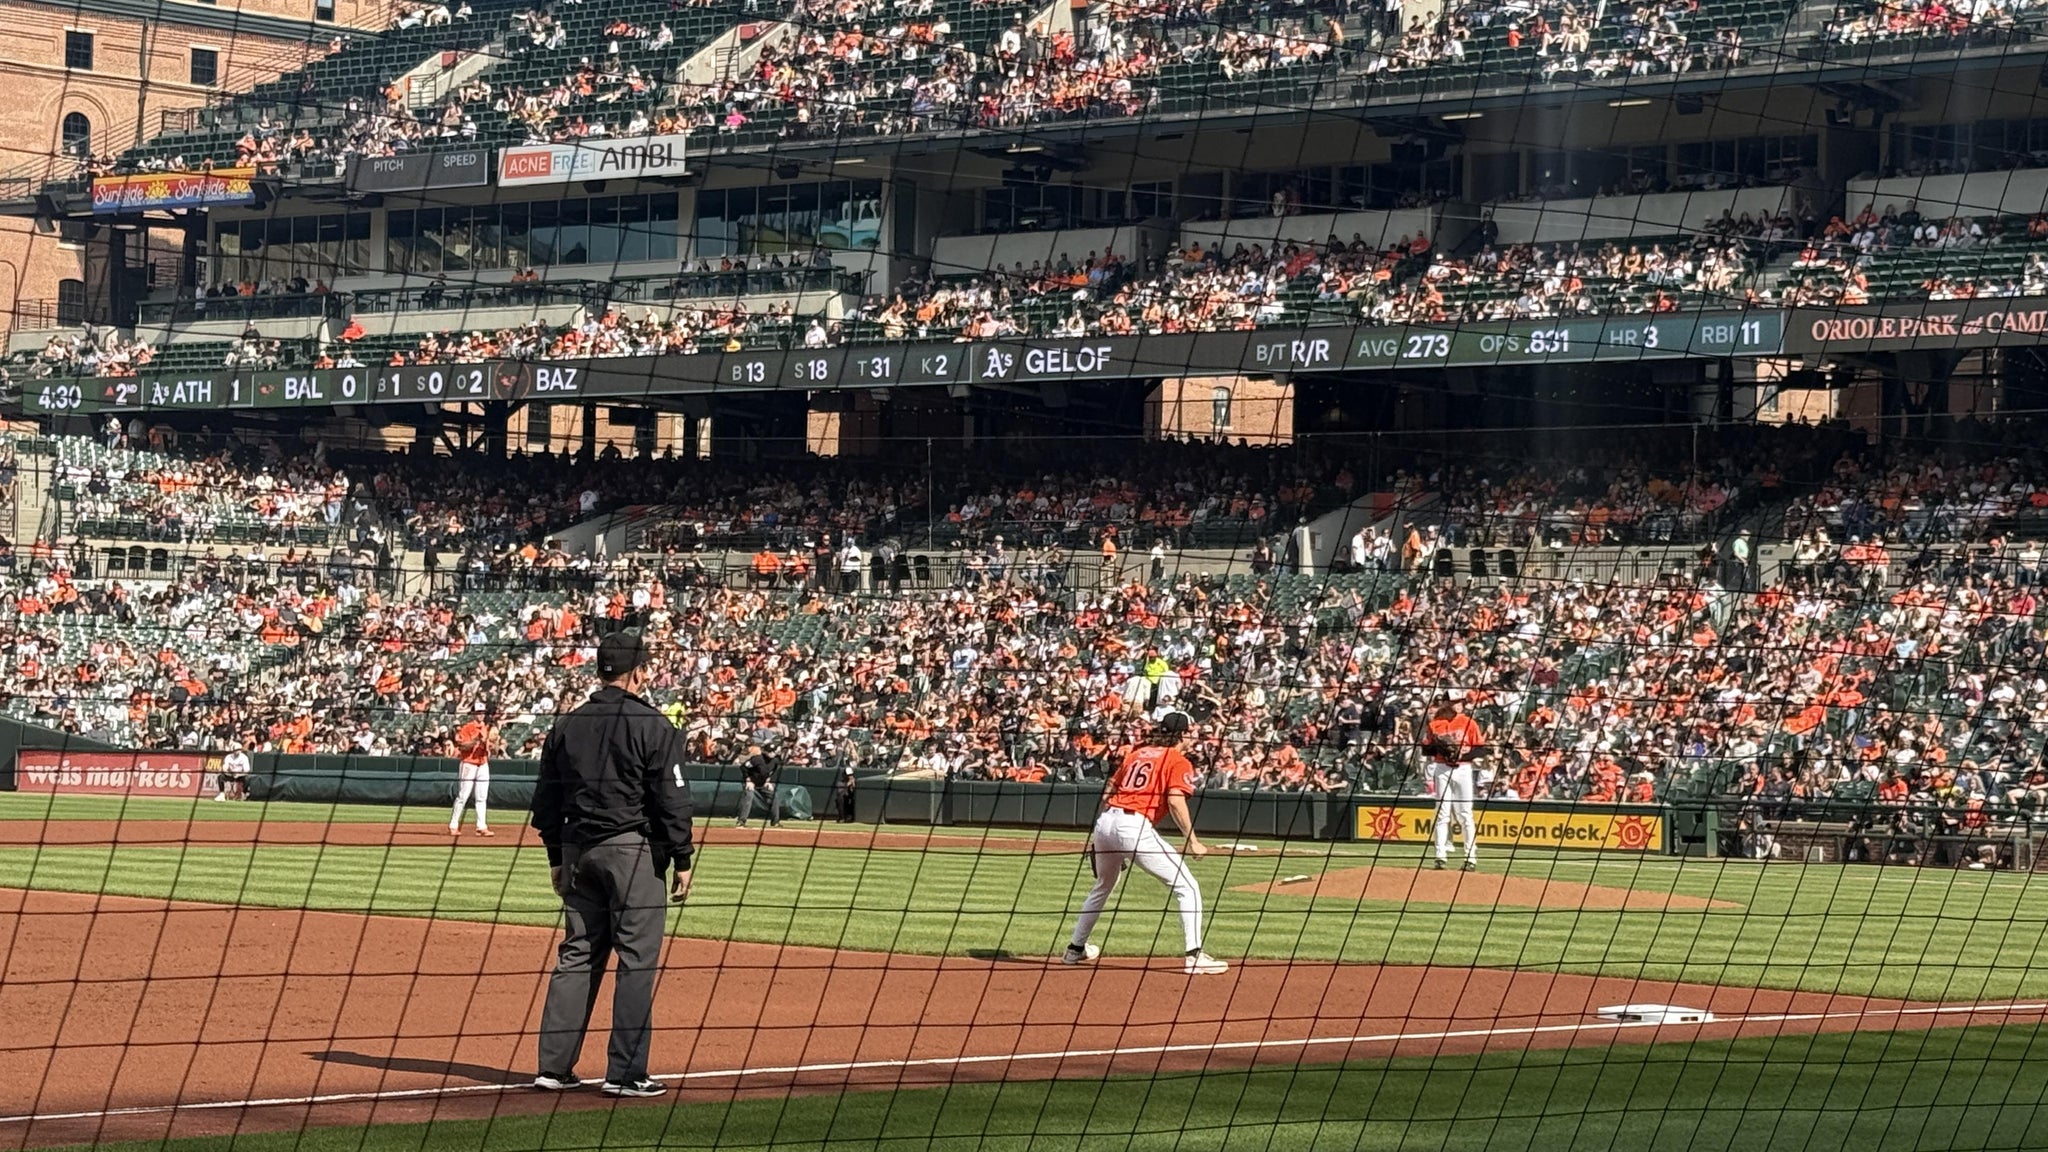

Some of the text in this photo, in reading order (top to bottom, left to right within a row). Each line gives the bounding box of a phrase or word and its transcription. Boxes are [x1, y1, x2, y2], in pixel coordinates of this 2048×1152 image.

[374, 160, 404, 172] PITCH
[443, 153, 476, 167] SPEED
[508, 153, 589, 174] ACNE FREE
[1610, 325, 1659, 348] HR 3
[1701, 321, 1760, 345] RBI 11
[1811, 317, 1897, 340] ORIOLE
[1898, 314, 1958, 338] PARK
[1961, 318, 1983, 335] at
[1256, 339, 1329, 367] B/T R/R
[1357, 334, 1449, 358] AVG .273
[1480, 335, 1519, 353] OPS
[732, 355, 948, 382] B 13 S 18 T 31 K 2
[1025, 346, 1112, 374] GELOF
[172, 380, 212, 403] ATH
[231, 379, 239, 401] 1
[285, 375, 356, 400] BAL 0
[378, 378, 386, 392] B
[391, 374, 399, 396] 1
[417, 376, 425, 391] S
[428, 372, 443, 394] 0
[469, 370, 483, 393] 2
[536, 368, 578, 391] BAZ
[38, 385, 82, 409] 4:30
[24, 760, 82, 786] weis
[85, 760, 192, 788] markets
[1122, 761, 1152, 789] 16
[1414, 818, 1606, 841] Me un is on deck.
